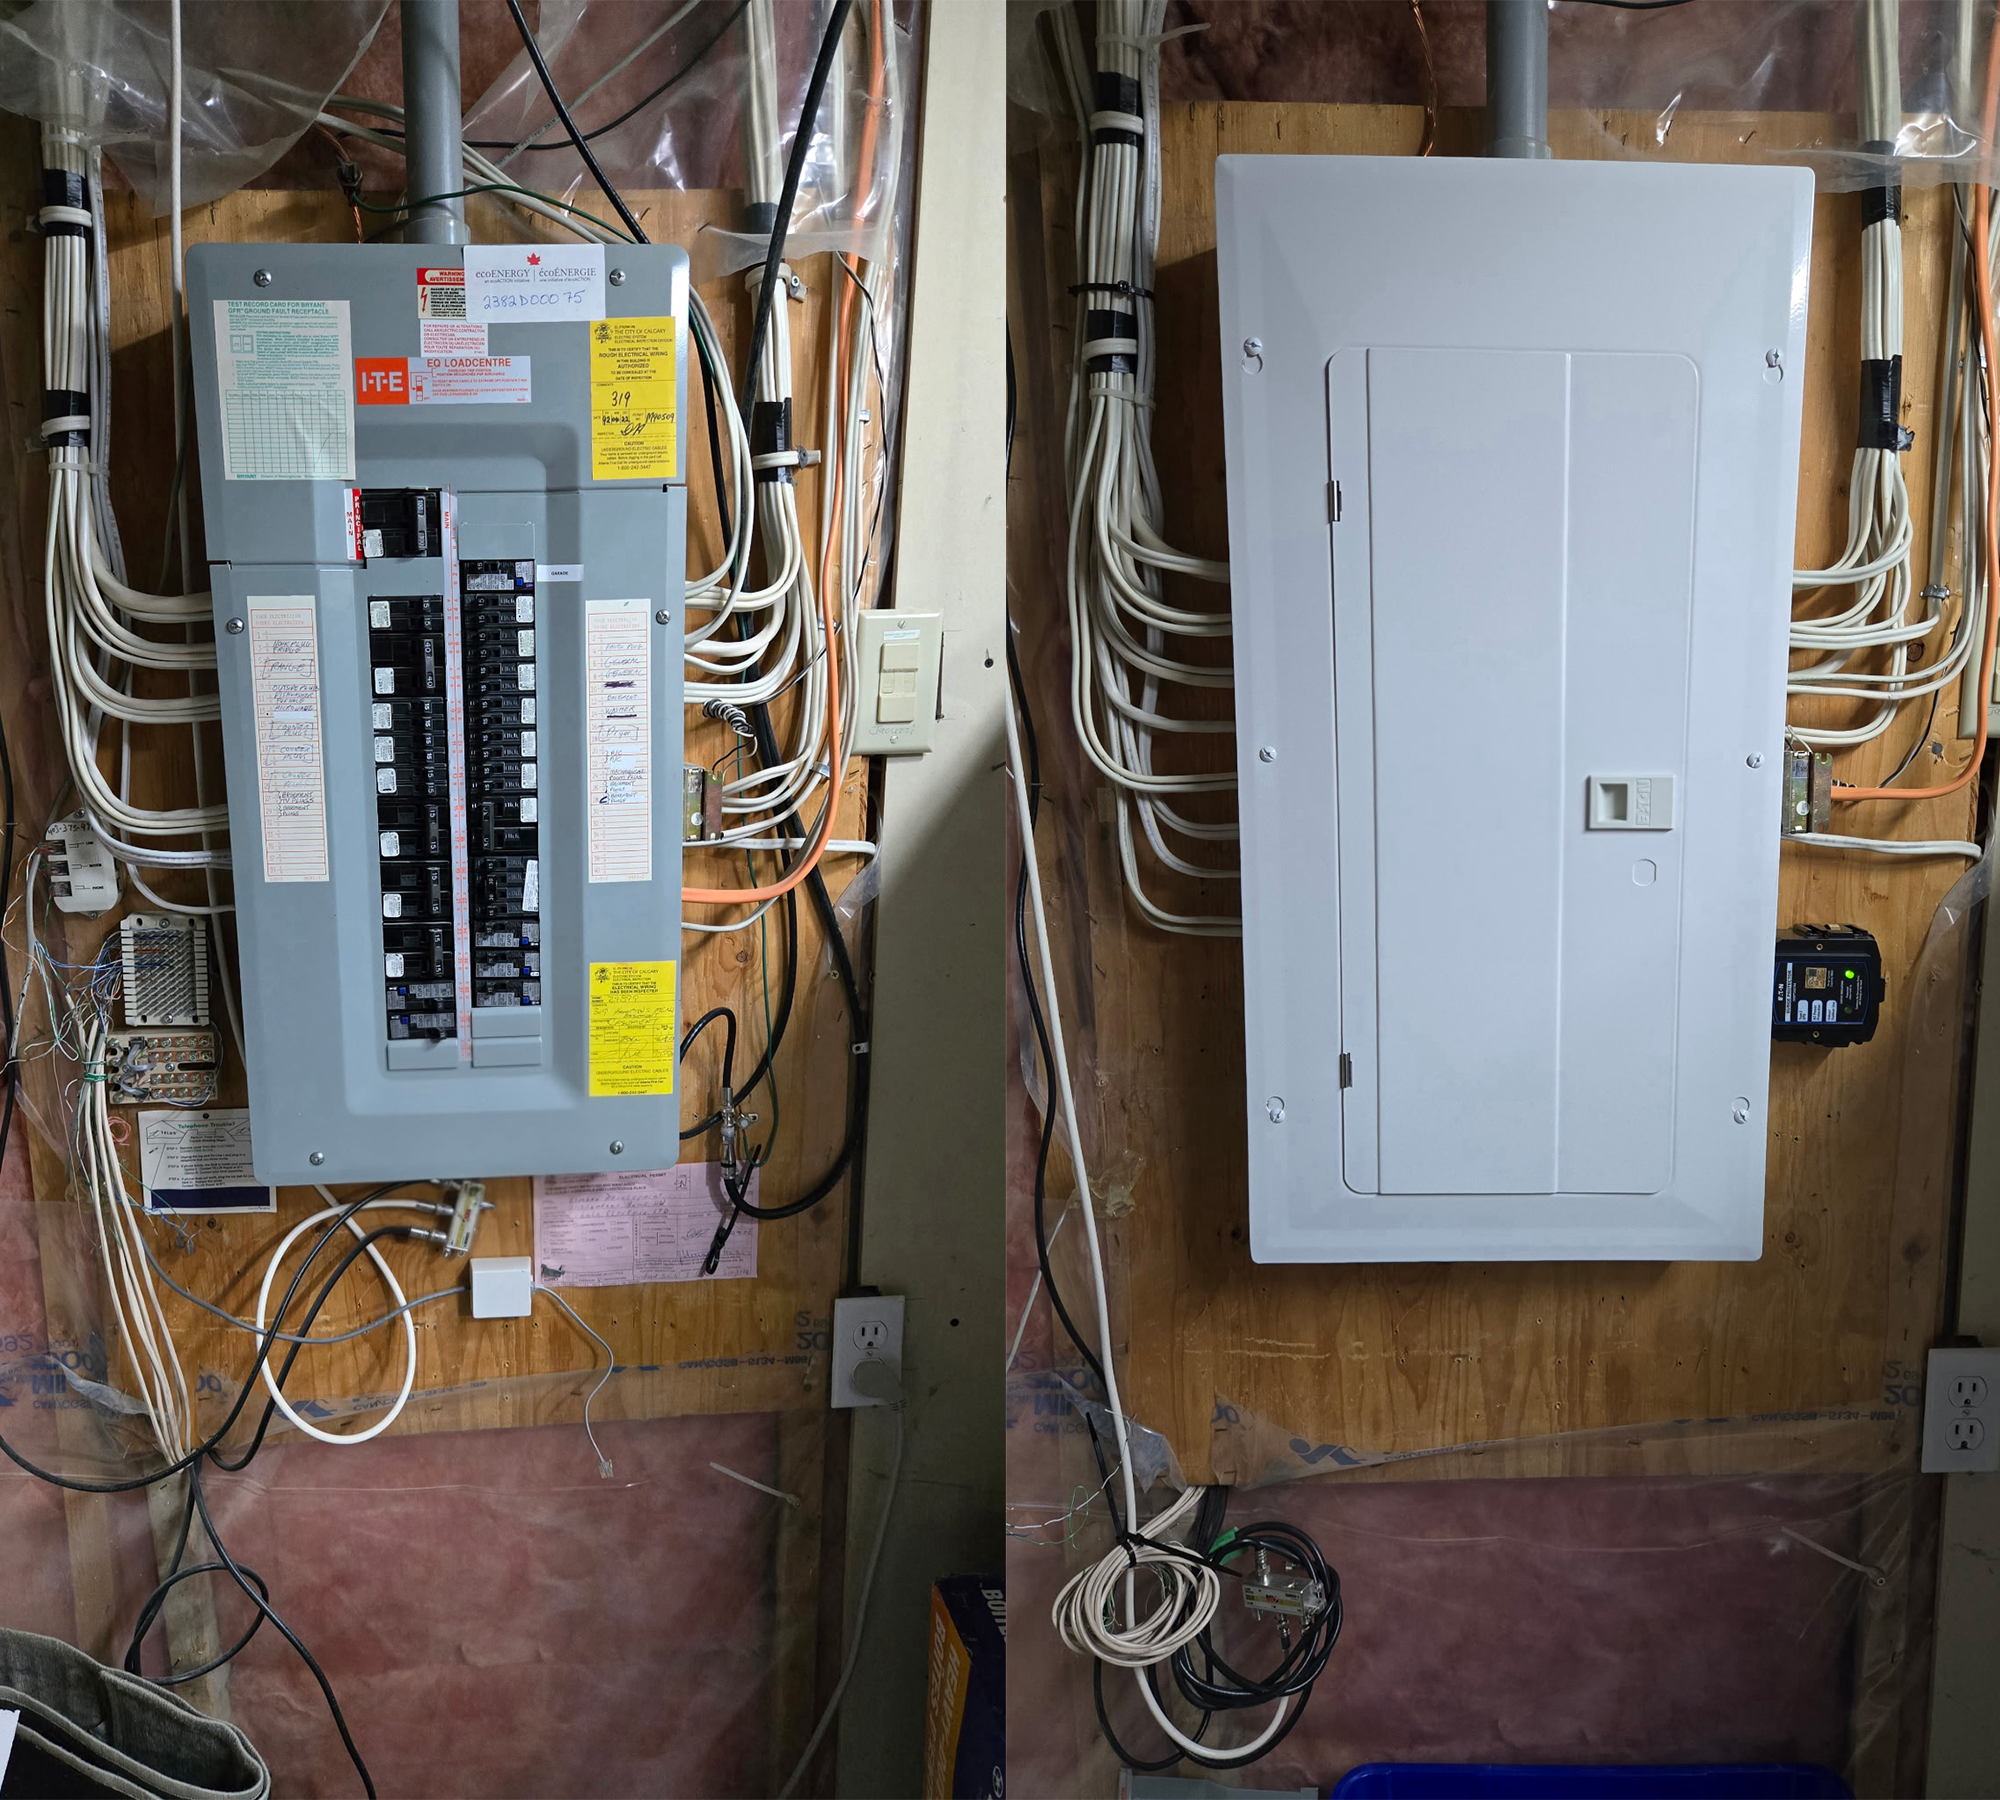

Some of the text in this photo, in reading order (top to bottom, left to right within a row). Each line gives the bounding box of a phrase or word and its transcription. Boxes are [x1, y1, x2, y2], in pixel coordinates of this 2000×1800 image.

[476, 269, 530, 278] ecoENERGY
[539, 267, 596, 276] écoÉNERGIE
[427, 358, 511, 367] EQ LOADCENTRE
[612, 391, 630, 407] 319
[271, 662, 306, 671] RANGE
